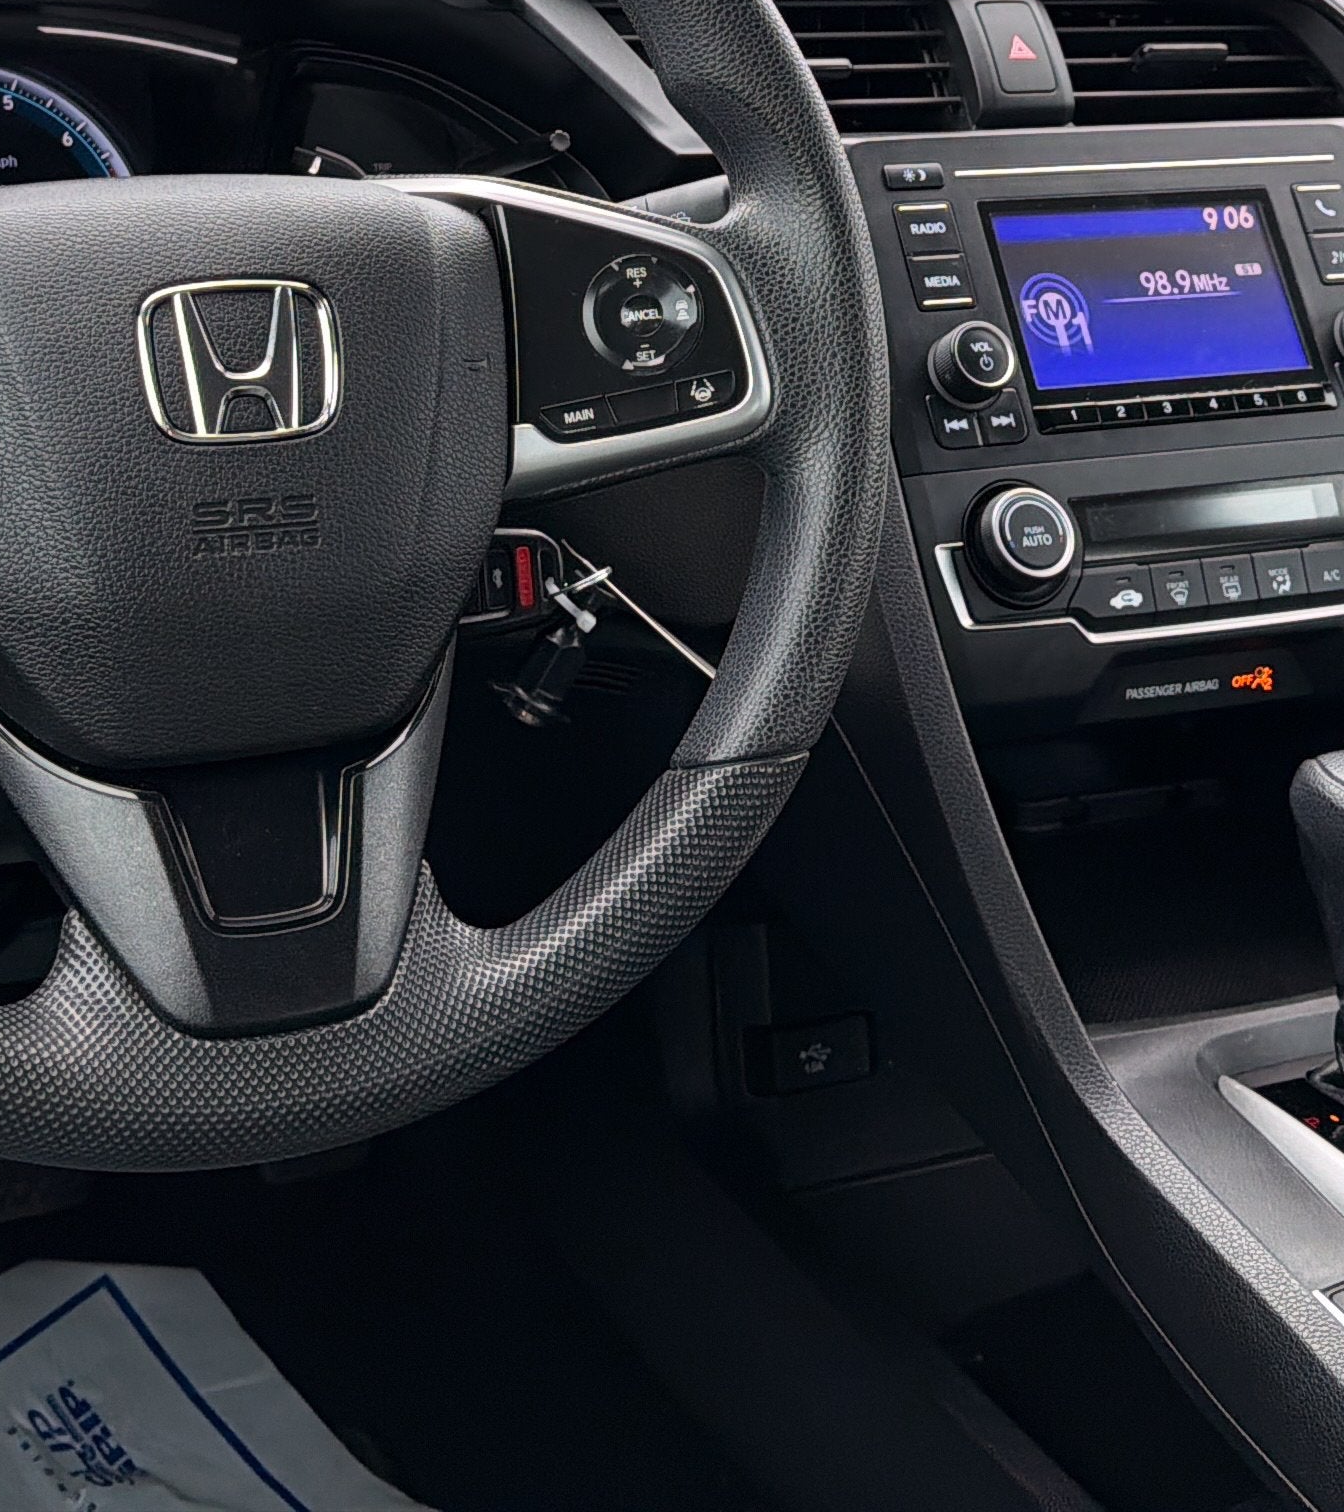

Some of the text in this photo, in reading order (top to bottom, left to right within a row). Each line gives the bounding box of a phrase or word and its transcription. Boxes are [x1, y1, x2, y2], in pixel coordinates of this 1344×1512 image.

[2, 95, 14, 111] 5
[62, 131, 74, 147] 6
[910, 222, 946, 235] RADIO
[626, 267, 647, 280] RES
[924, 275, 960, 288] MEDIA
[622, 309, 662, 322] CANCEL
[970, 341, 993, 353] VOL
[636, 350, 656, 362] SET
[564, 408, 594, 424] MAIN
[1070, 410, 1078, 423] 1
[1116, 406, 1126, 418] 2
[1162, 402, 1172, 414] 3
[1209, 398, 1218, 410] 4
[192, 493, 319, 528] SRS
[1024, 526, 1045, 535] PUSH
[192, 530, 322, 560] AIRBAG
[1023, 534, 1053, 548] AUTO
[1323, 569, 1341, 583] A/C
[1166, 581, 1189, 590] FRONT
[1126, 674, 1254, 700] PASSENGER AIRBAG OFF
